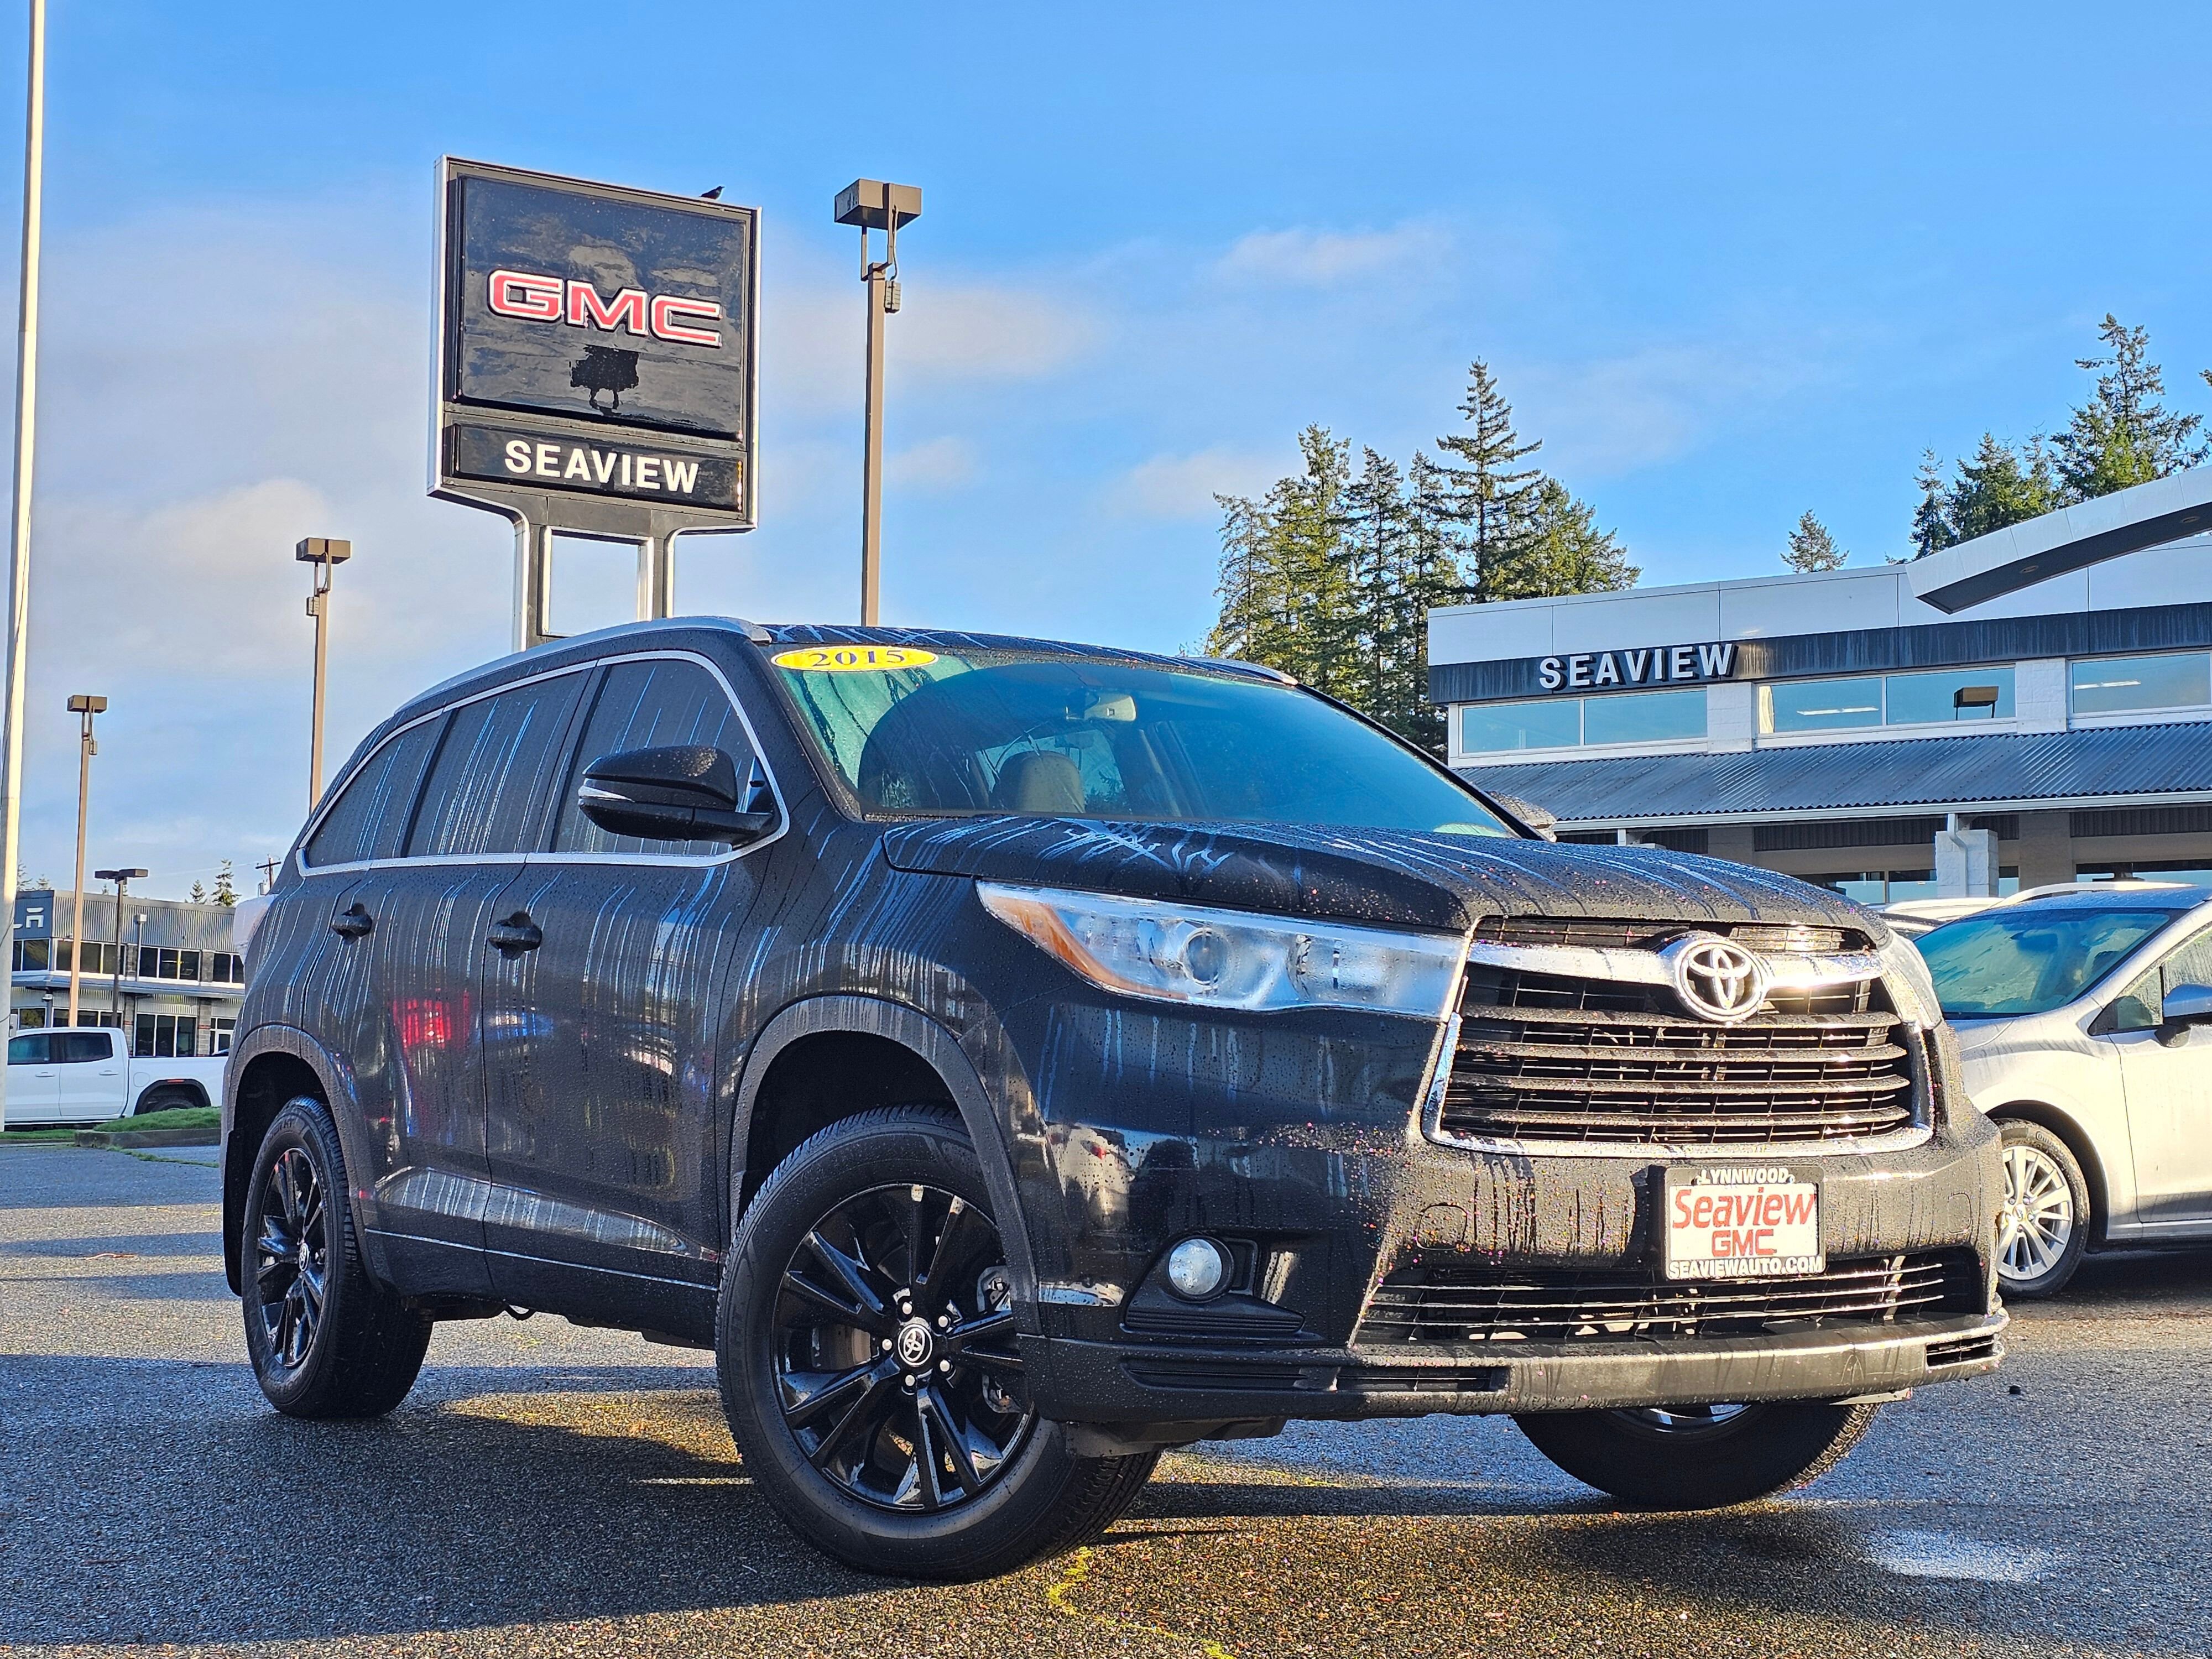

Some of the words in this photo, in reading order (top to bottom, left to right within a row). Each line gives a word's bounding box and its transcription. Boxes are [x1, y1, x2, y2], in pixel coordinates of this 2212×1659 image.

[488, 268, 723, 348] GMC
[505, 440, 700, 494] SEAVIEW
[808, 649, 905, 667] 2015
[1539, 643, 1735, 690] SEAVIEW
[1700, 1167, 1790, 1185] LYNNWOOD
[1672, 1186, 1815, 1229] Seaview
[1712, 1228, 1777, 1258] GMC
[1669, 1257, 1823, 1279] SEAVIEWAUTO.COM
